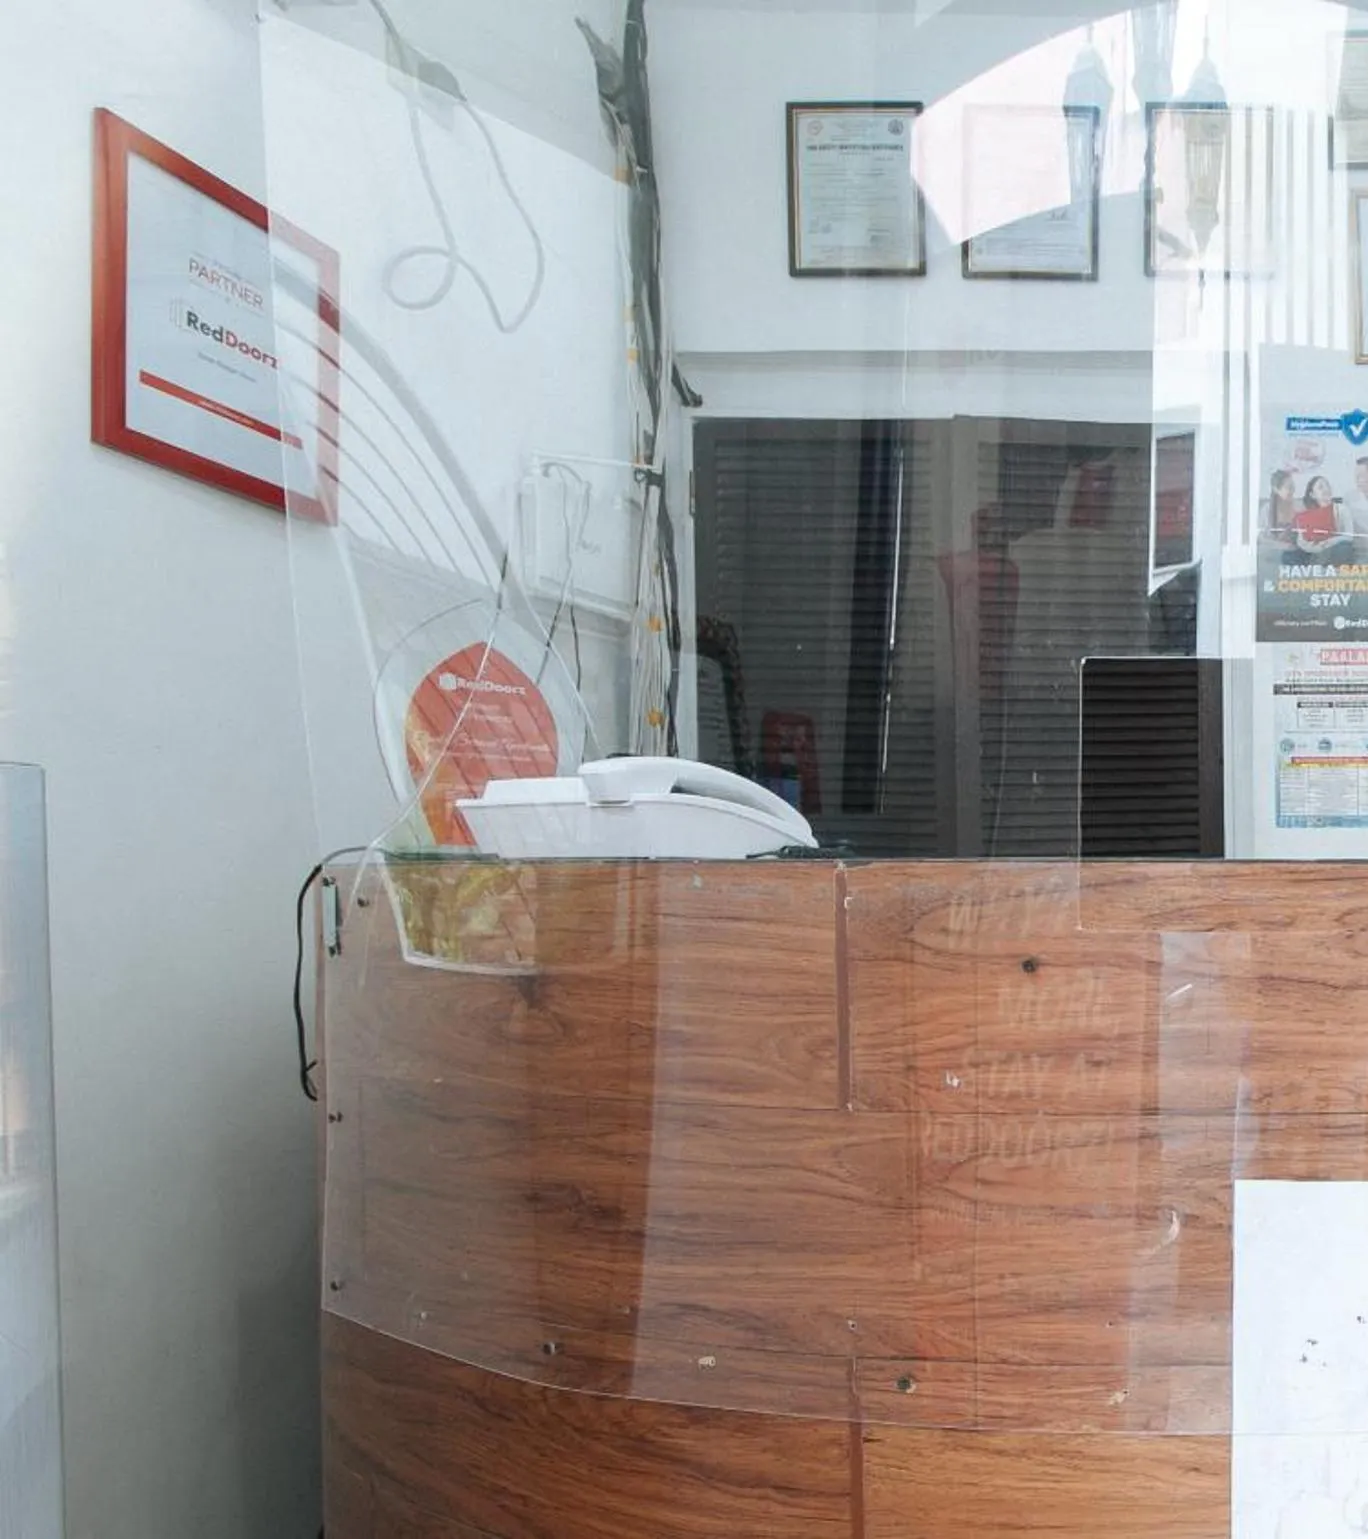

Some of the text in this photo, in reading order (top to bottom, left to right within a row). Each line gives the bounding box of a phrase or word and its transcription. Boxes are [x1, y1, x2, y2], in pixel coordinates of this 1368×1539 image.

[188, 258, 264, 308] PARTNER
[1279, 564, 1321, 578] HAVE
[1326, 564, 1337, 578] A
[1264, 578, 1275, 592] &
[1310, 593, 1352, 607] STAY
[457, 676, 526, 696] RedDoorz
